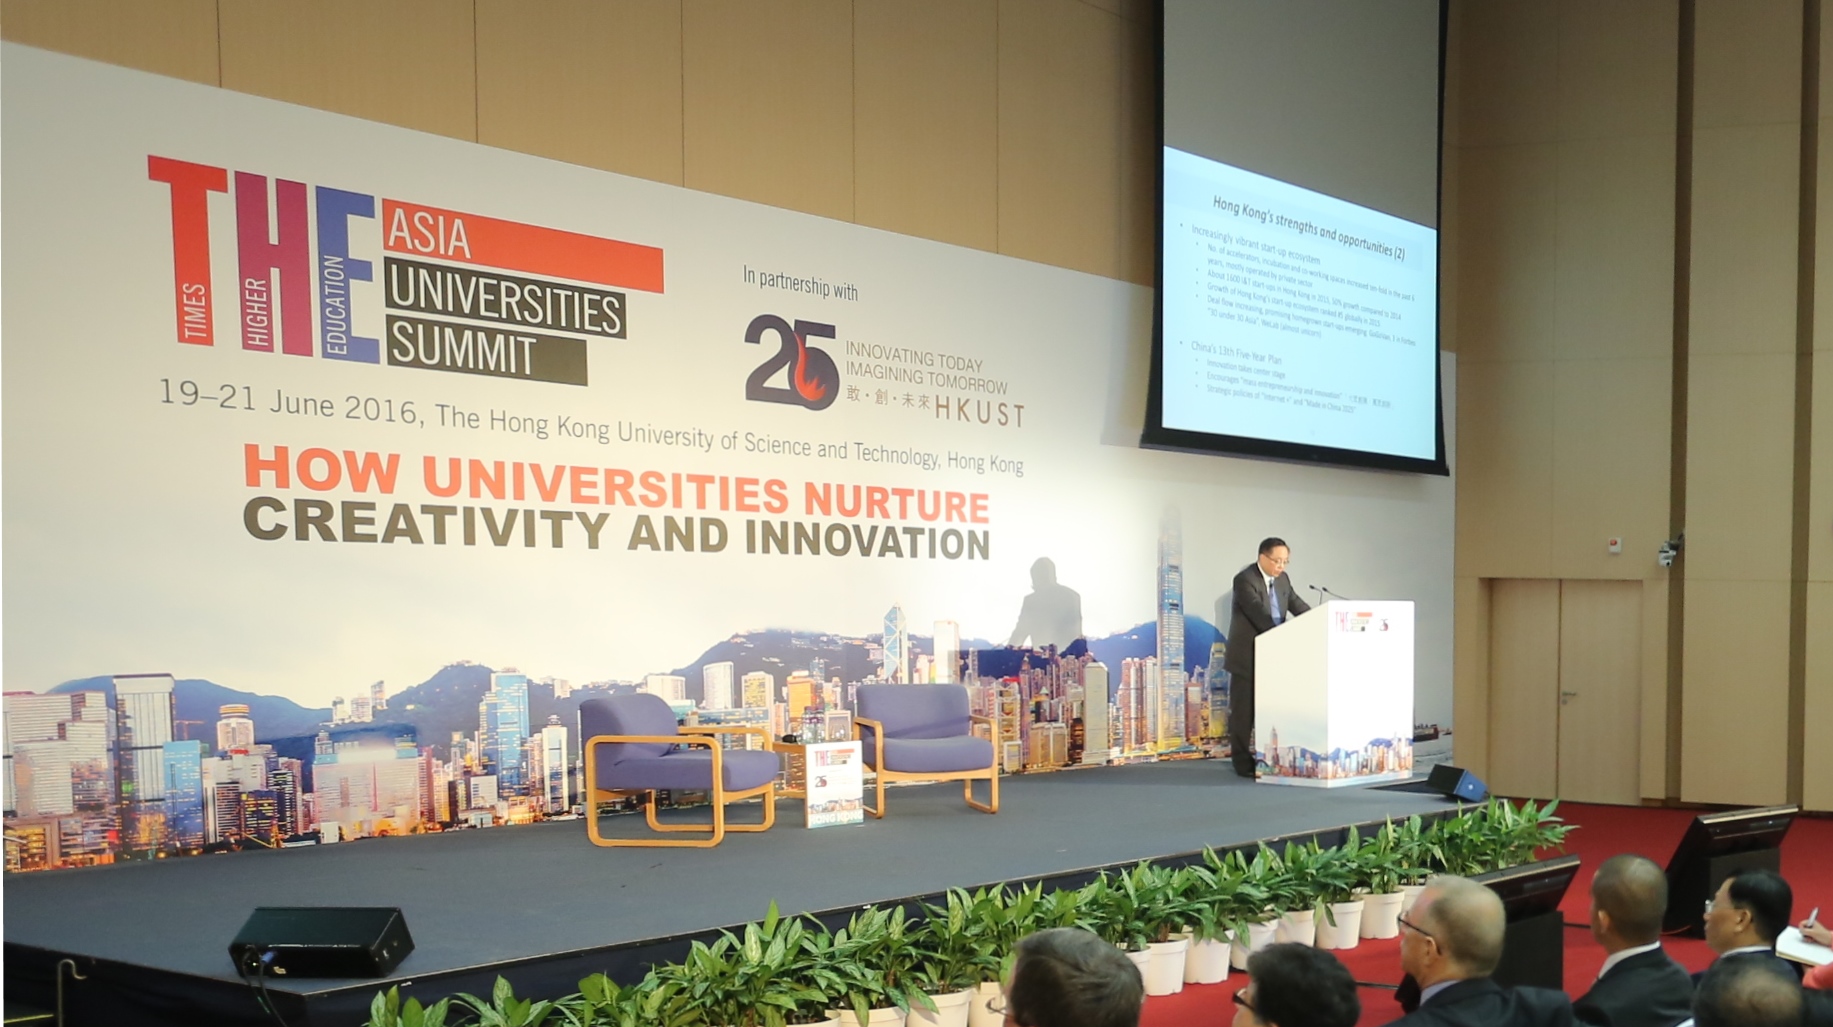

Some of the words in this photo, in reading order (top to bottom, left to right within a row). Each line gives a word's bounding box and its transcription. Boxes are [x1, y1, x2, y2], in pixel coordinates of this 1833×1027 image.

[388, 208, 471, 258] ASIA
[1192, 224, 1233, 244] Increasingly
[1236, 236, 1259, 250] vibrant
[1261, 244, 1286, 258] start-up
[1289, 251, 1320, 265] ecosystem
[1214, 195, 1240, 216] Hong
[1243, 204, 1273, 224] Kong's
[1276, 215, 1317, 235] strengths
[1320, 228, 1337, 240] and
[1339, 234, 1392, 257] opportunities
[1395, 247, 1405, 263] (2)
[148, 155, 380, 364] THE
[744, 264, 755, 283] In
[760, 272, 830, 299] partnership
[834, 282, 858, 301] with
[1226, 262, 1244, 273] mostly
[1246, 267, 1270, 278] operated
[1271, 271, 1277, 280] by
[1279, 275, 1296, 284] private
[326, 255, 345, 355] EDUCATION
[391, 264, 621, 333] UNIVERSITIES
[1208, 269, 1225, 279] About
[1227, 274, 1240, 283] 1600
[1283, 288, 1296, 297] Hong
[1298, 291, 1310, 301] Kong
[1208, 282, 1228, 293] Growth
[1237, 289, 1252, 300] Hong
[1208, 295, 1220, 304] Deal
[1222, 298, 1233, 307] flow
[183, 283, 206, 338] TIMES
[246, 277, 267, 346] HIGHER
[392, 323, 537, 376] SUMMIT
[744, 314, 840, 411] 25
[846, 340, 934, 367] INNOVATING
[938, 354, 983, 373] TODAY
[1207, 359, 1237, 370] Innovation
[1219, 346, 1234, 356] 13th
[1237, 349, 1265, 362] Five-Year
[1269, 354, 1282, 365] Plan
[847, 361, 923, 384] IMAGINING
[927, 372, 1008, 395] TOMORROW
[270, 389, 335, 417] June
[345, 396, 425, 428] 2016,
[435, 404, 480, 430] The
[490, 409, 549, 440] Hong
[557, 416, 610, 445] Kong
[617, 422, 714, 452] University
[721, 430, 738, 450] of
[745, 431, 811, 456] Science
[818, 441, 848, 460] and
[854, 443, 942, 470] Technology,
[948, 451, 985, 475] Hong
[990, 454, 1024, 478] Kong
[935, 395, 1025, 428] HKUST
[244, 443, 401, 495] HOW
[422, 455, 789, 513] UNIVERSITIES
[805, 481, 990, 524] NURTURE
[243, 496, 610, 550] CREATIVITY
[627, 514, 728, 553] AND
[746, 519, 990, 561] INNOVATION
